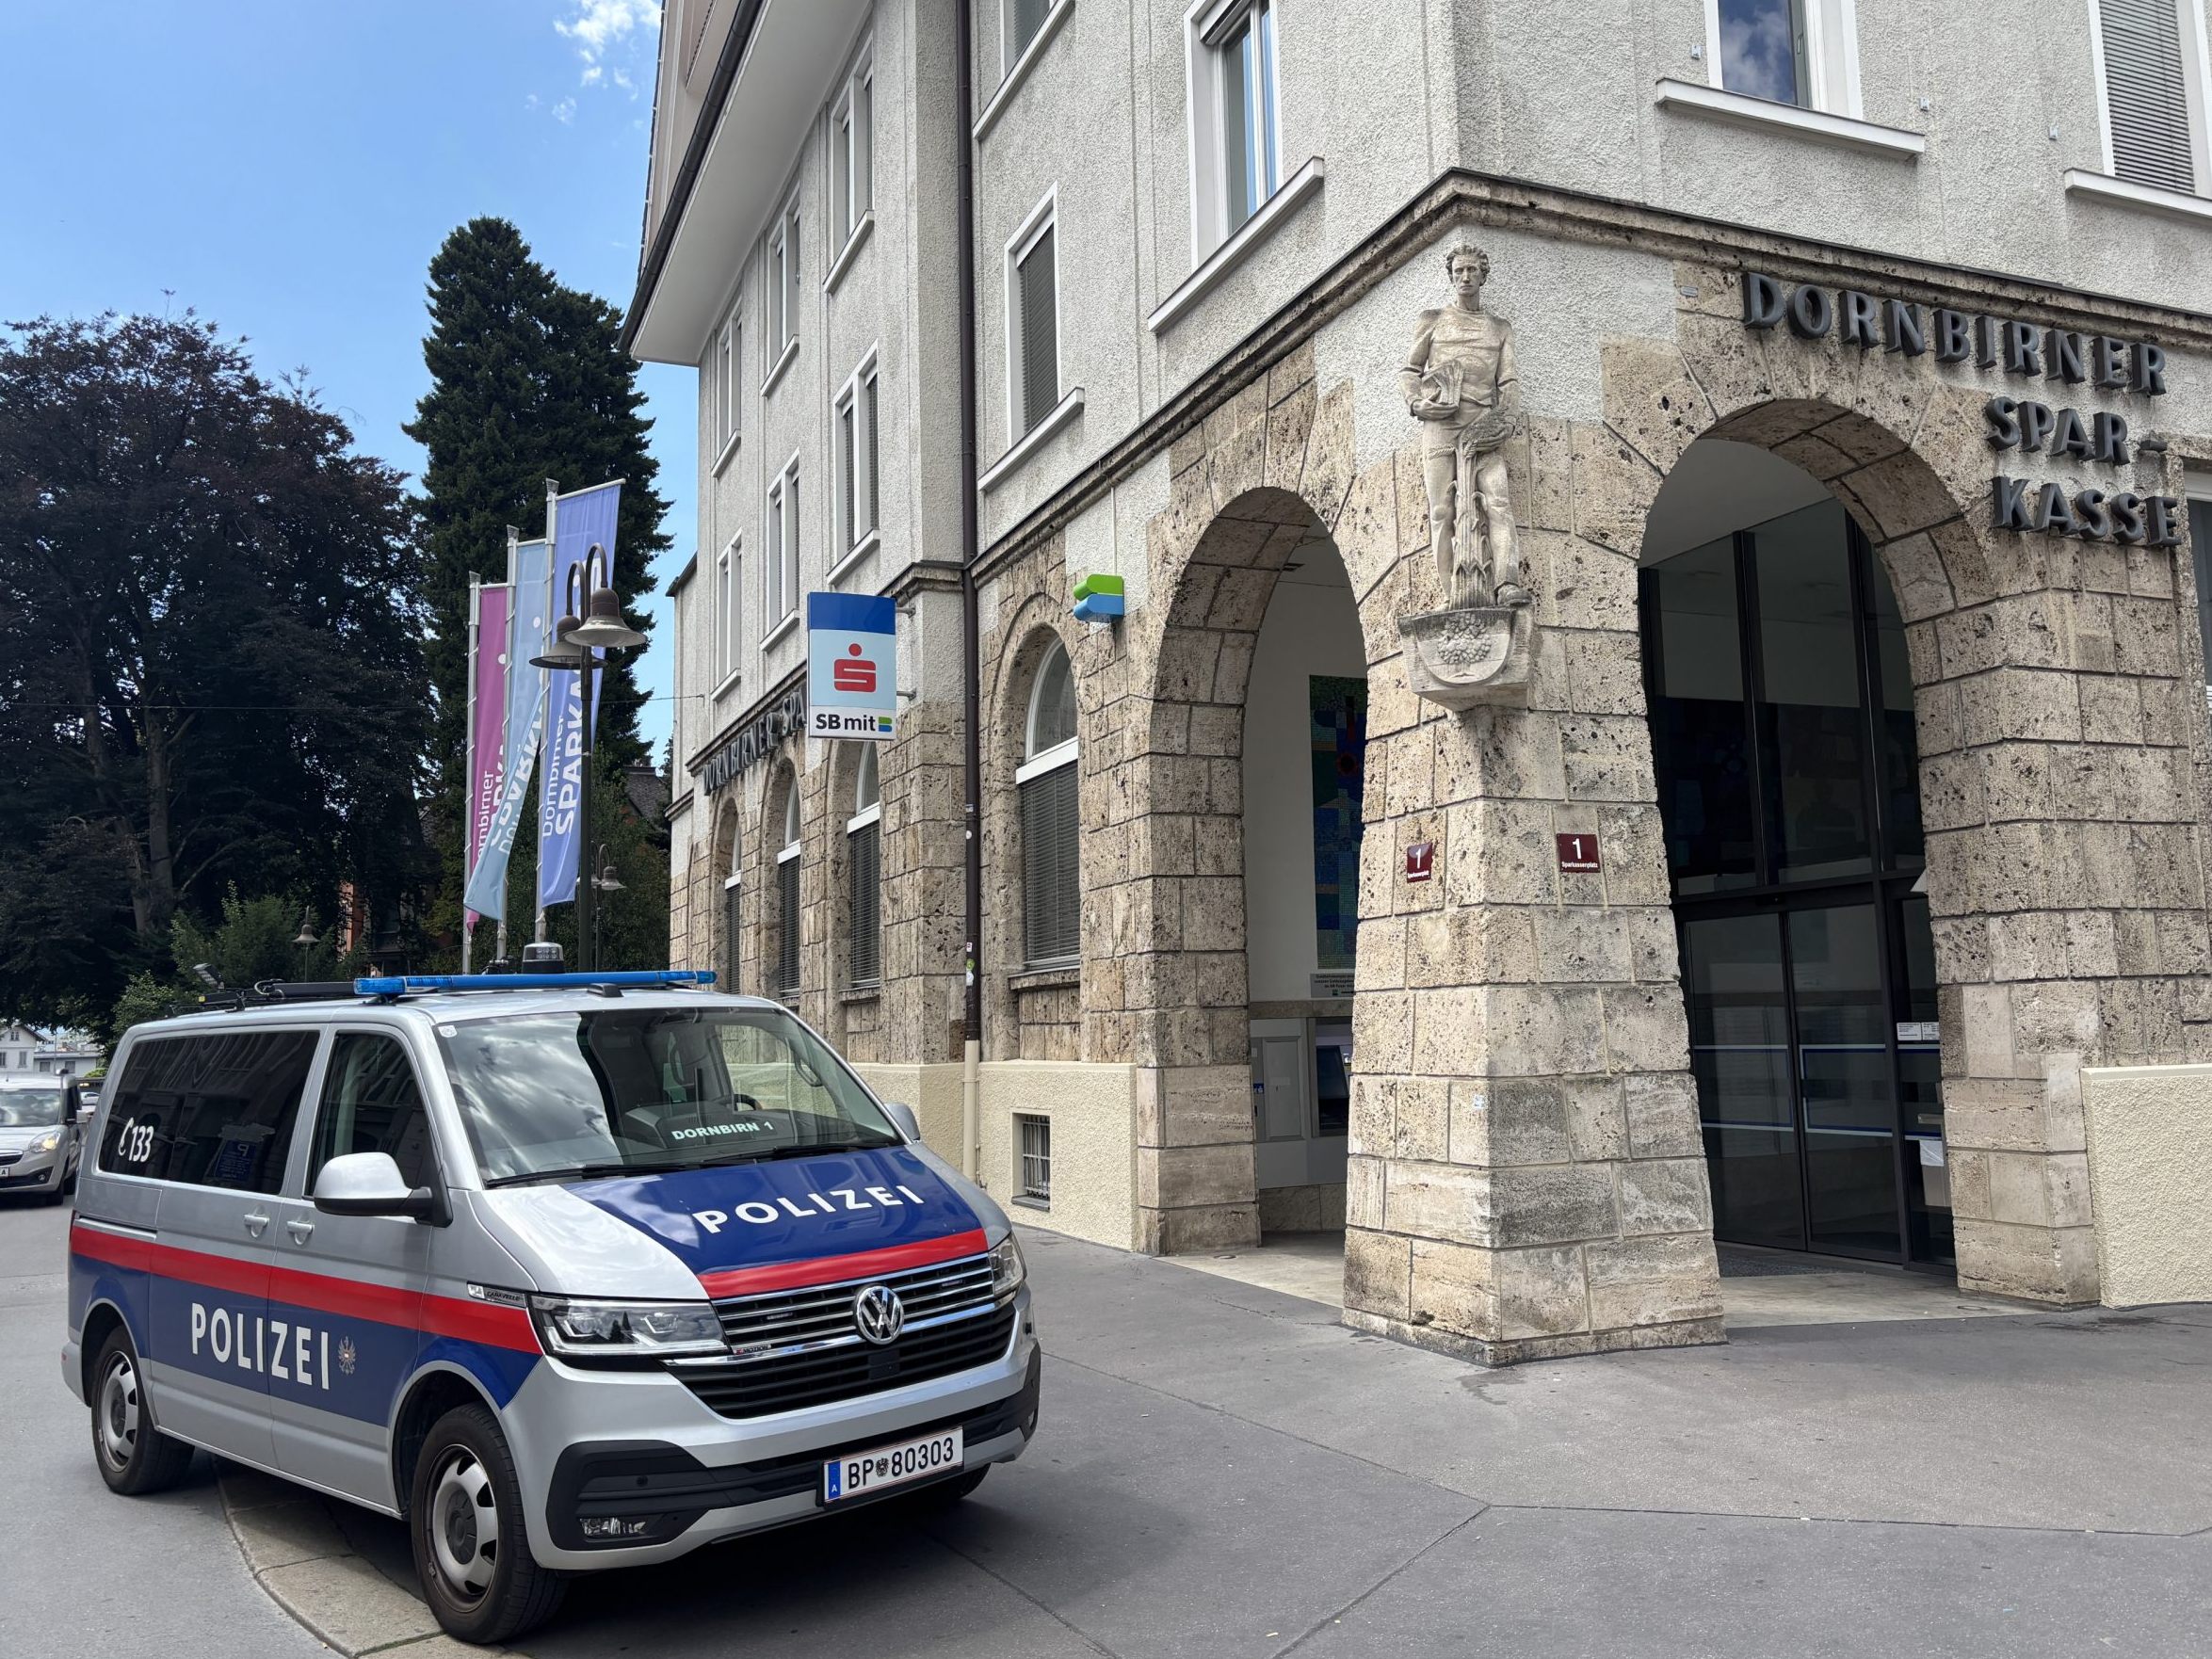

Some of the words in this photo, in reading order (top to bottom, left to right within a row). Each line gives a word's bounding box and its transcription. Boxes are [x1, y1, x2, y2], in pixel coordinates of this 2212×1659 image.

[1743, 272, 2166, 395] DORNBIRNER
[1990, 475, 2182, 547] KASSE
[815, 713, 841, 730] SB
[844, 714, 876, 732] mit
[1415, 848, 1422, 869] 1
[1572, 837, 1582, 860] 1
[129, 1125, 154, 1162] 133
[671, 1122, 760, 1140] DORNBIRN
[764, 1120, 774, 1130] 1
[692, 1185, 925, 1234] POLIZEI
[191, 1302, 330, 1391] POLIZEI
[848, 1458, 875, 1490] BP
[891, 1437, 954, 1477] 80303
[832, 1484, 838, 1492] A
